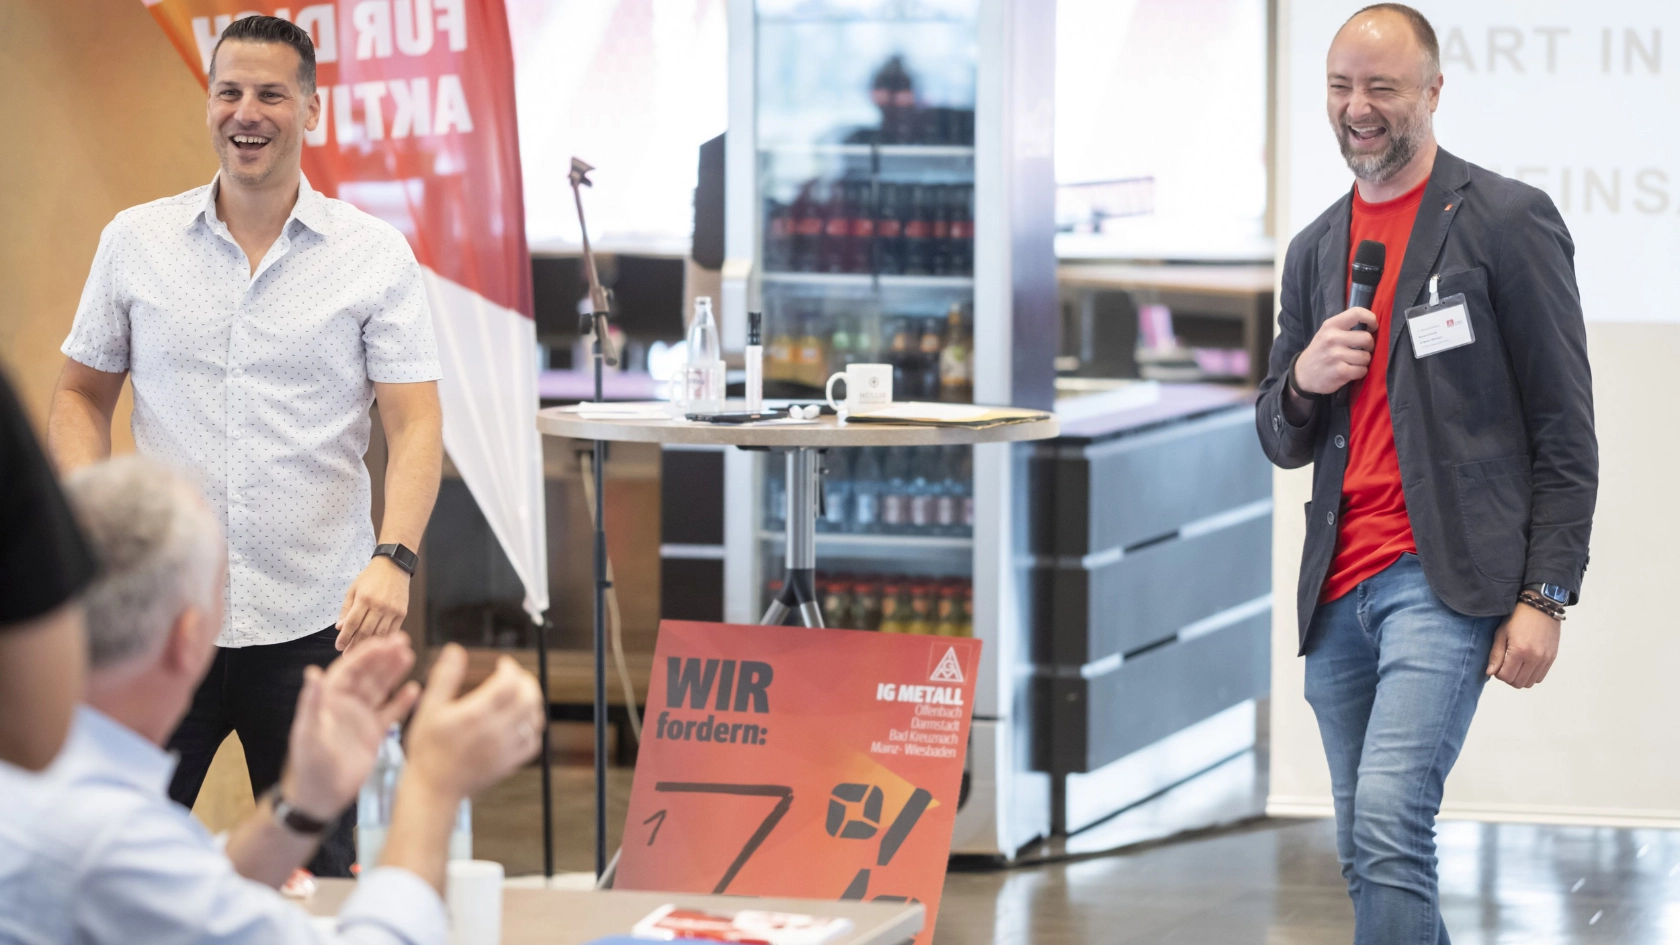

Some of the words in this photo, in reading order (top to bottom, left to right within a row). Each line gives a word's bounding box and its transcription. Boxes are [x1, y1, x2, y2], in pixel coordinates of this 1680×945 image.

[1438, 26, 1571, 75] ART
[1600, 26, 1662, 75] IN
[1491, 165, 1680, 217] EINS
[666, 656, 774, 714] WIR
[876, 682, 896, 702] IG
[897, 684, 964, 706] METALL
[914, 704, 963, 718] Offenbach
[656, 711, 768, 746] fordern:
[910, 717, 961, 732] Darmstadt
[889, 729, 908, 742] Bad
[909, 730, 959, 745] Kreuznach
[904, 743, 957, 758] Wiesbaden
